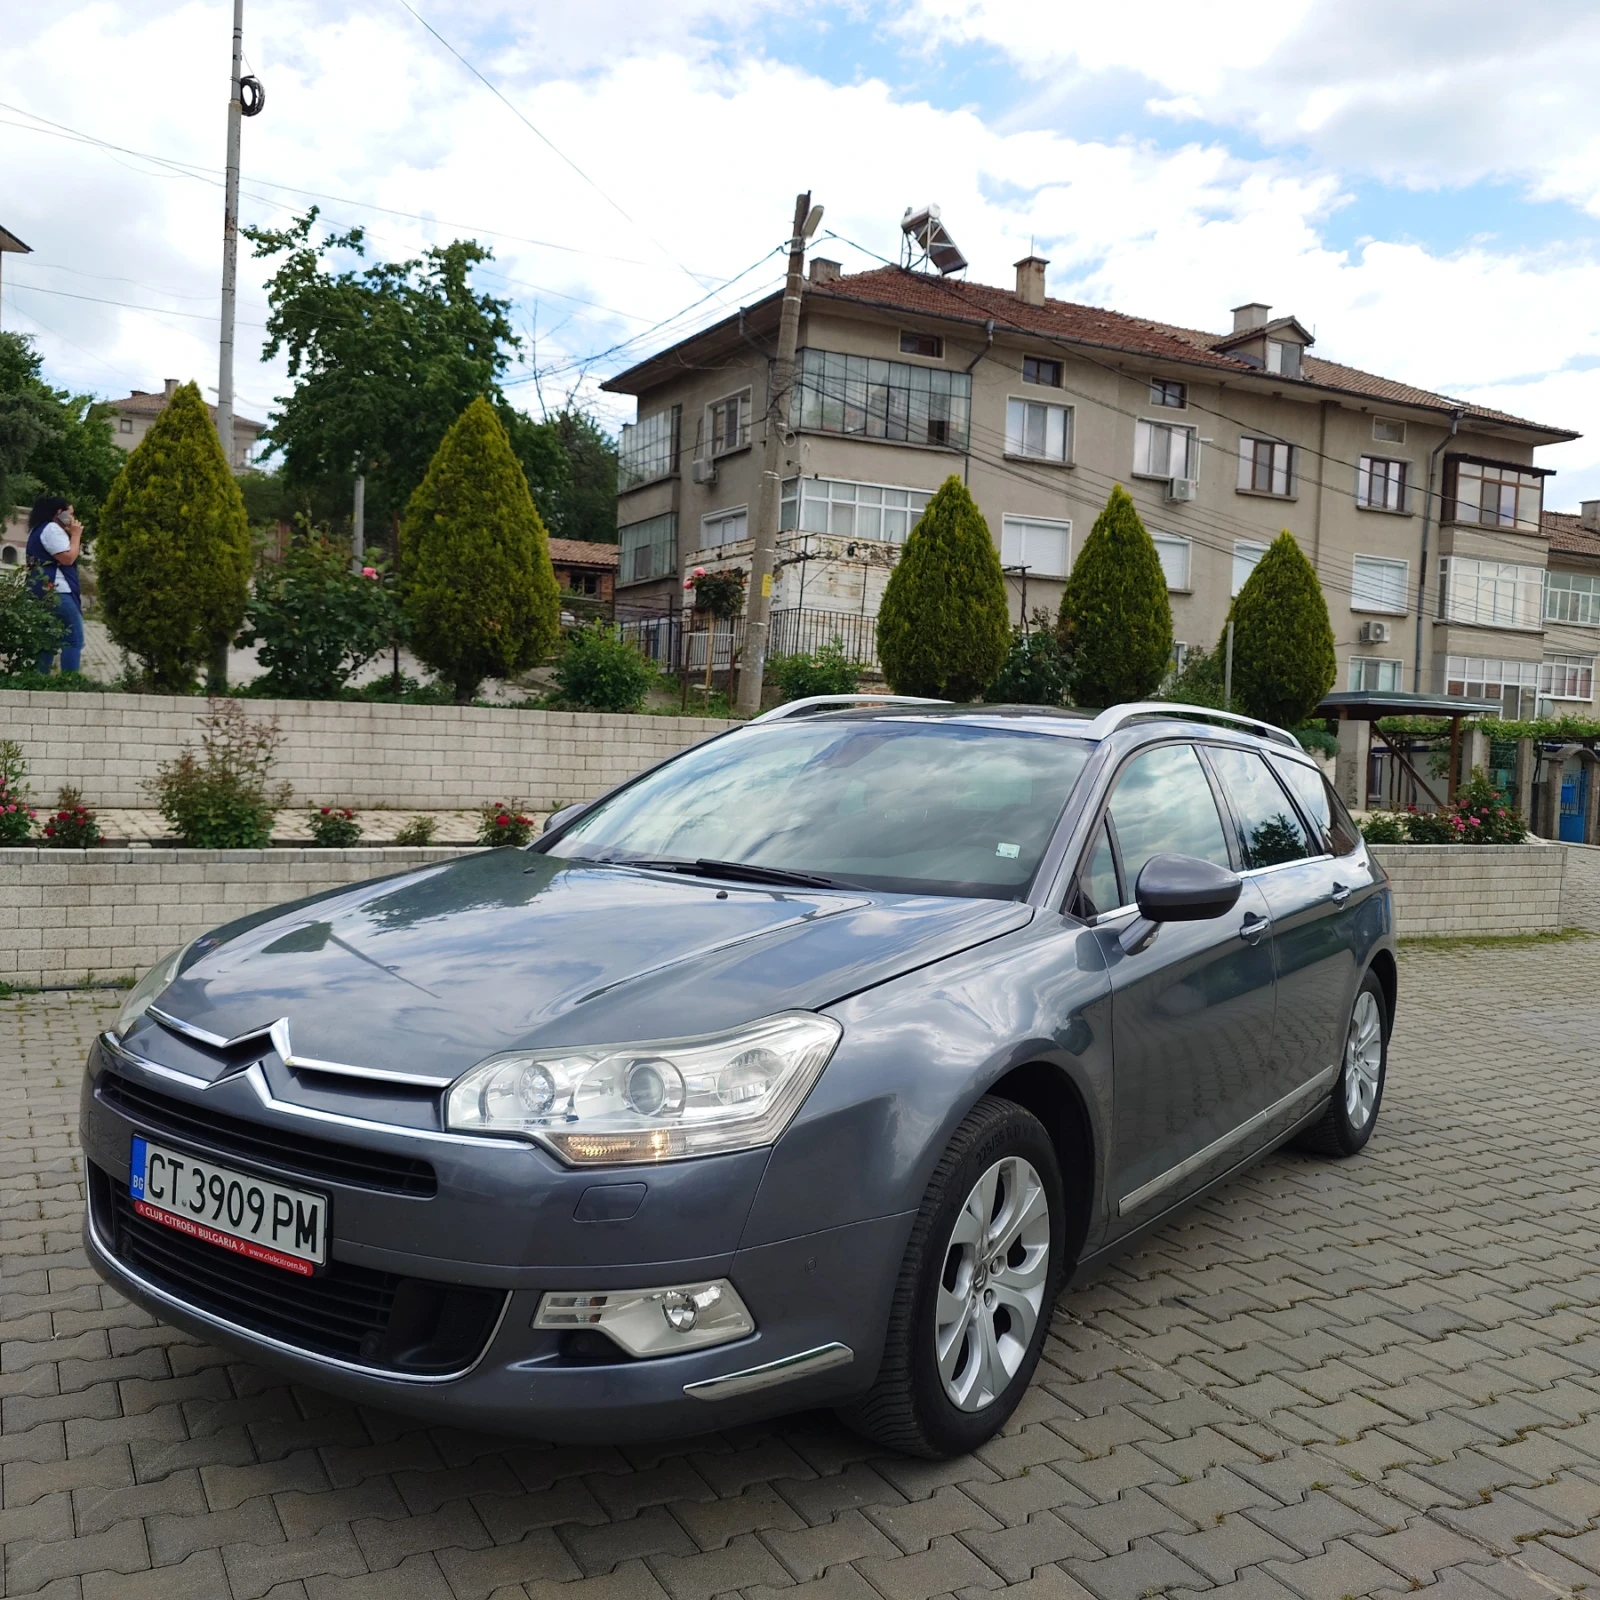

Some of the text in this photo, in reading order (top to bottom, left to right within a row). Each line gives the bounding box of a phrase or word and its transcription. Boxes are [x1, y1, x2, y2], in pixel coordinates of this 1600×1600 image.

[132, 1174, 144, 1190] BG
[145, 1207, 308, 1274] CLUB CITROËN BULGARIA www.clubcitroen.bg
